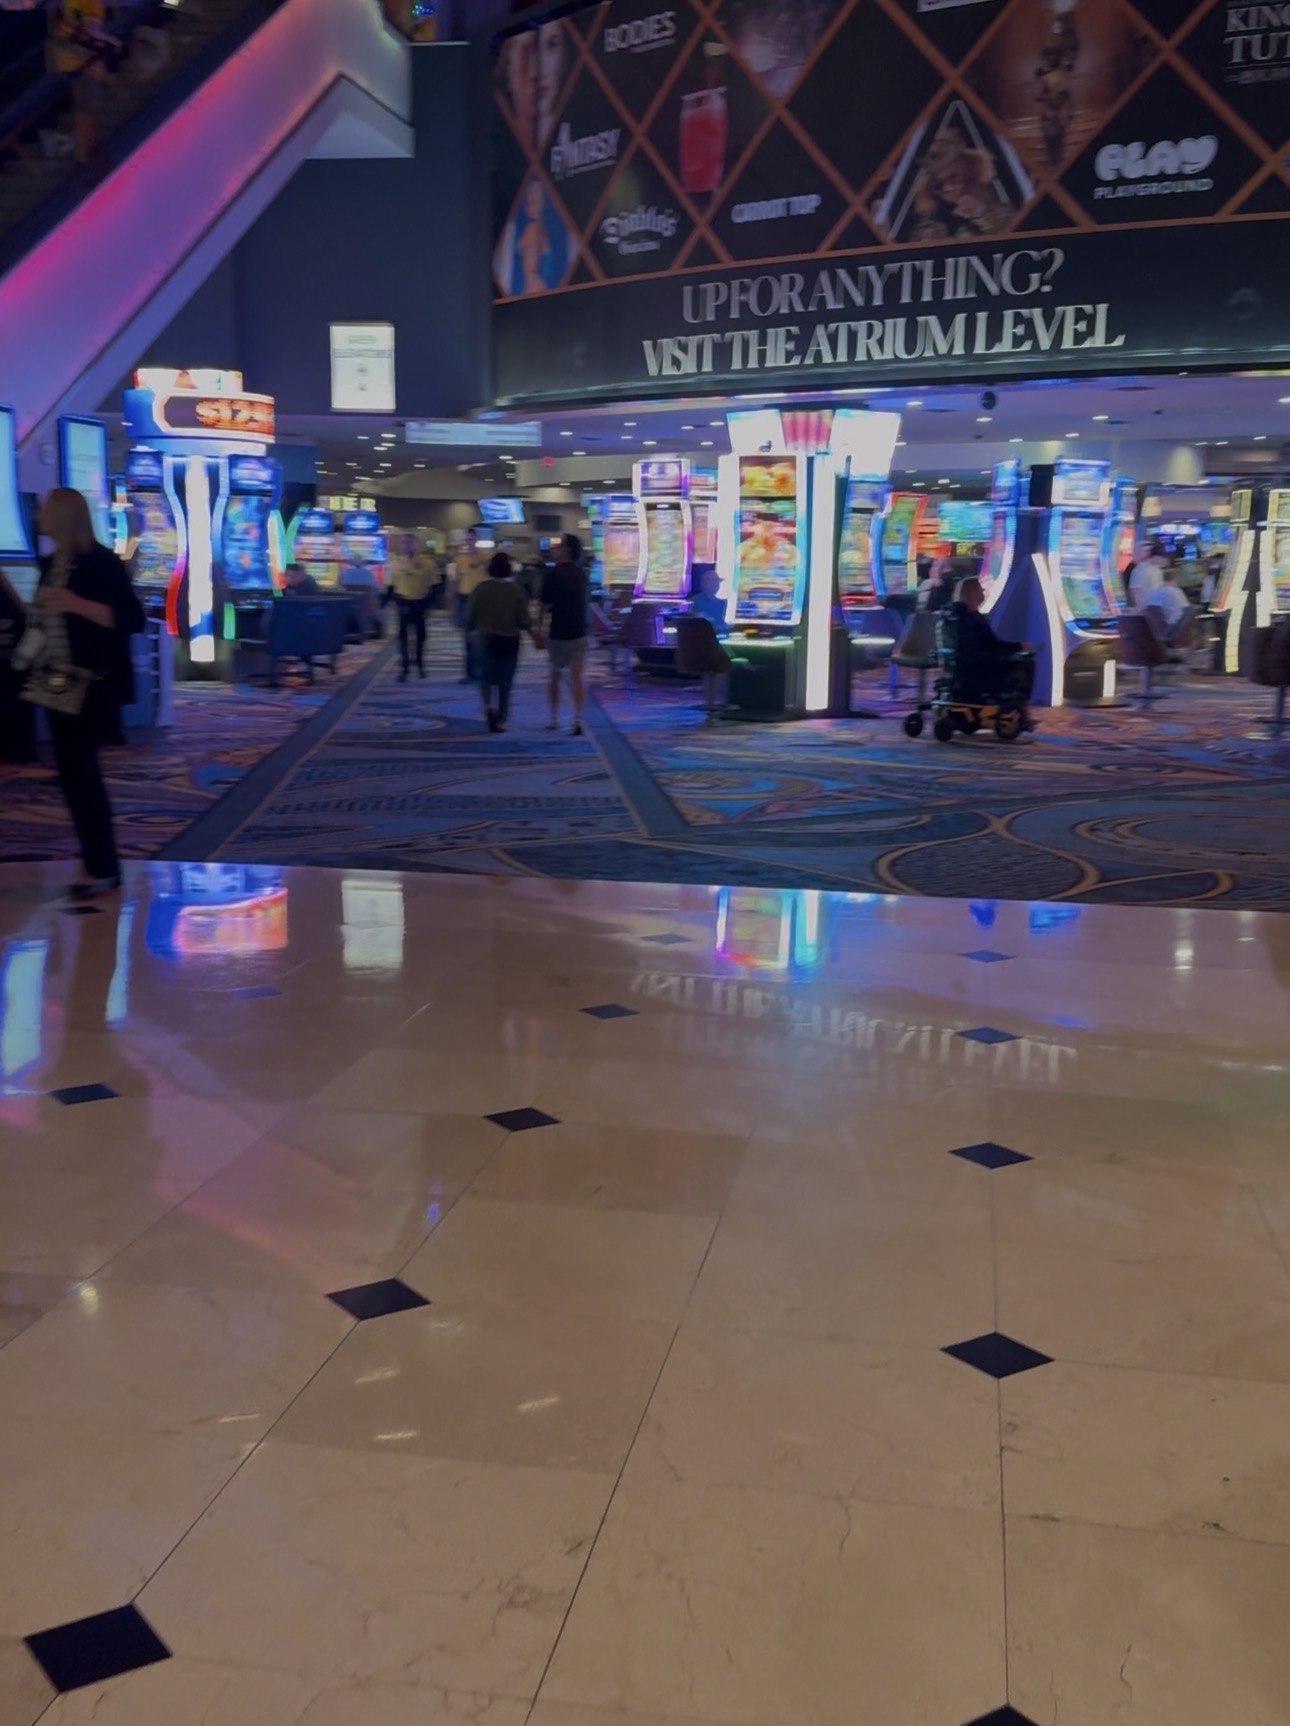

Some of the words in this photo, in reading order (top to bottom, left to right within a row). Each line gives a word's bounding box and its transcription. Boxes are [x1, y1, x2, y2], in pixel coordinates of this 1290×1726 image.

[604, 11, 676, 53] BODIES
[1094, 135, 1218, 181] PLAY
[682, 282, 729, 323] UP
[729, 273, 806, 317] FOR
[807, 247, 1065, 311] ANYTHING?
[642, 333, 722, 377] VISIT
[724, 326, 802, 370] THE
[803, 313, 968, 365] ATRIUM
[972, 303, 1127, 354] LEVEL
